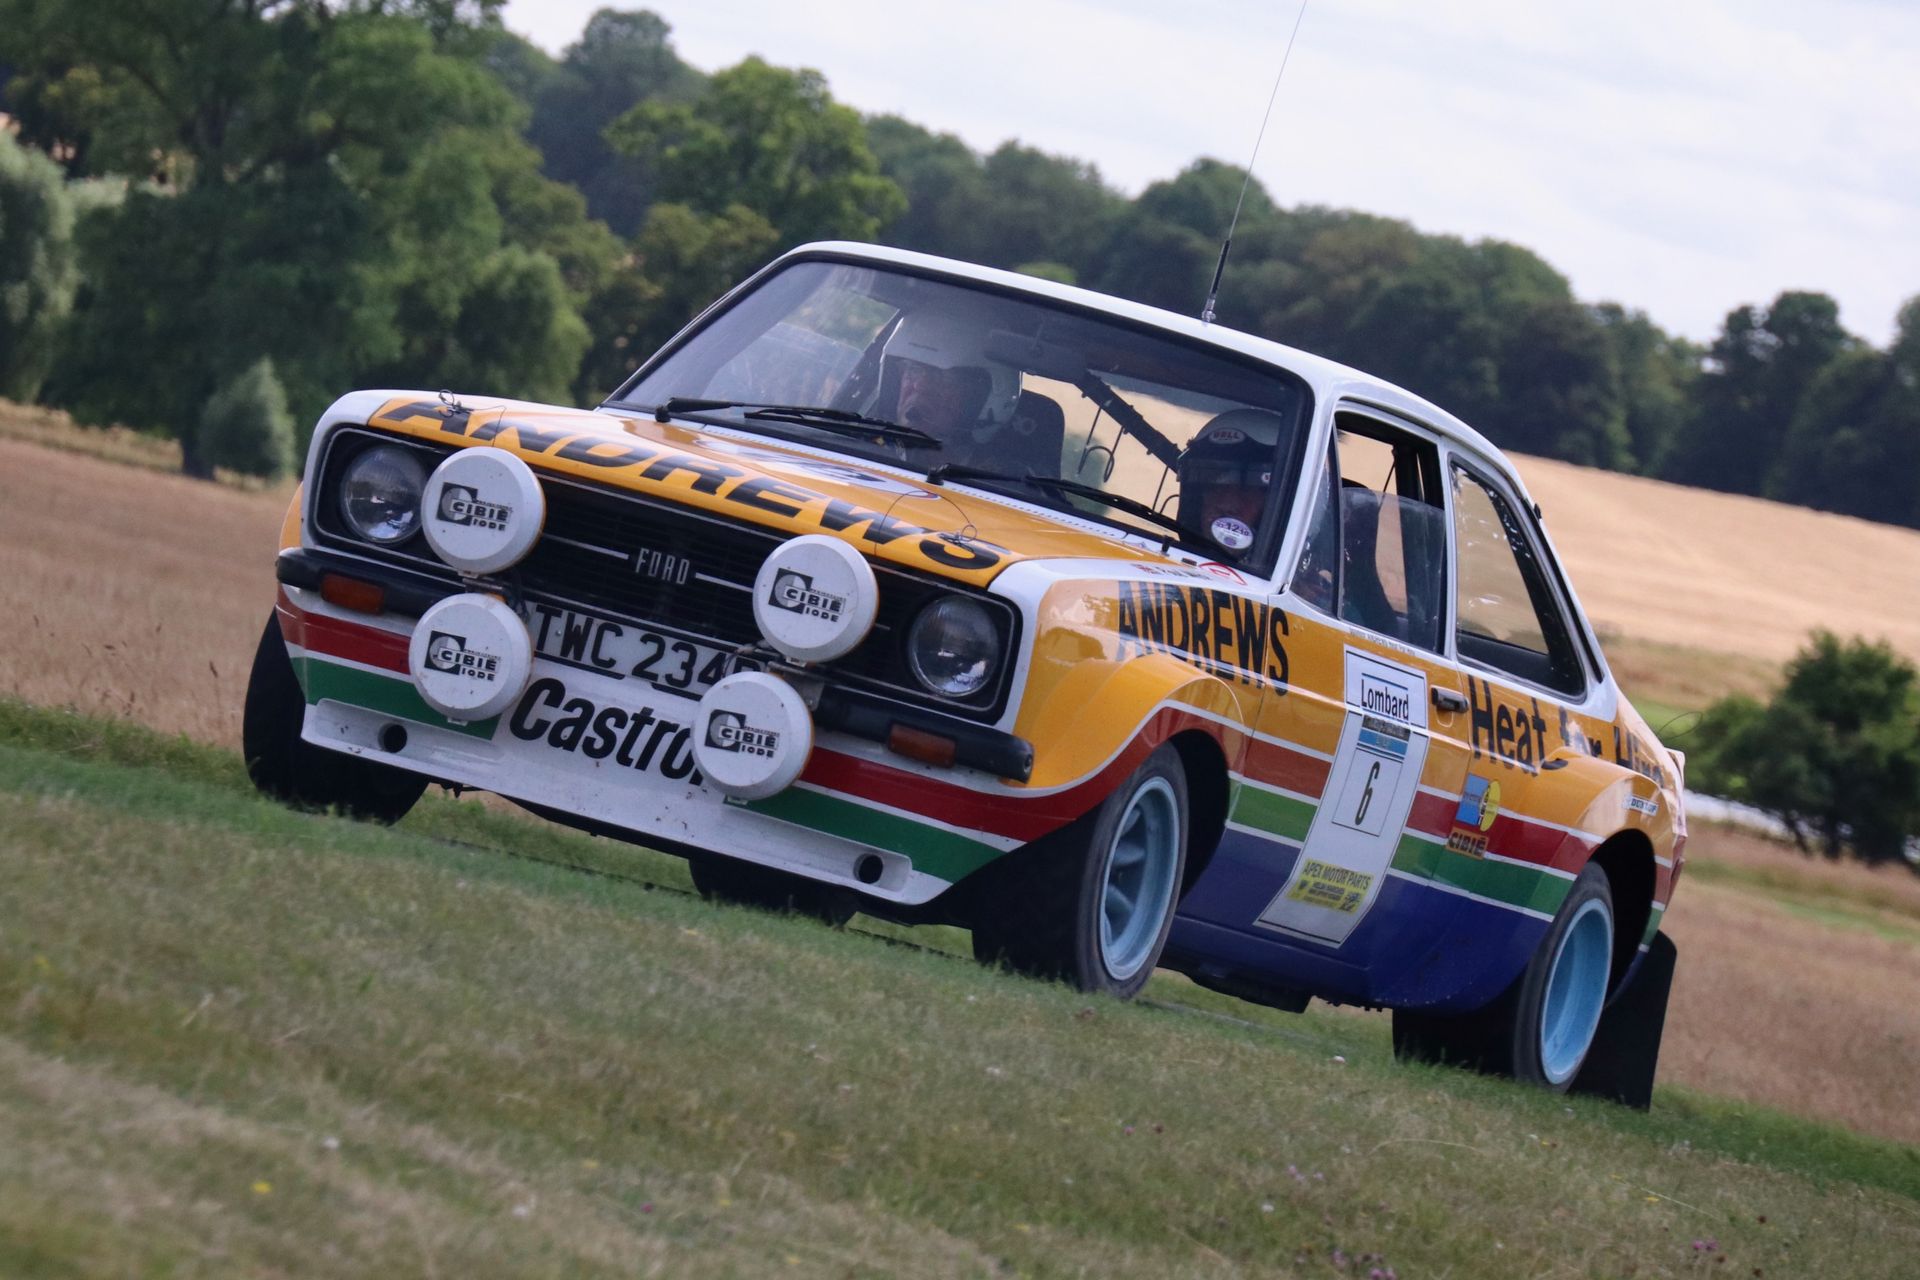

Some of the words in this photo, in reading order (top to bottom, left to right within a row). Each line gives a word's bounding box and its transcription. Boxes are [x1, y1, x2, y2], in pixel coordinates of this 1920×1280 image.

[379, 401, 1012, 569] ANDREWS
[635, 548, 691, 586] FORD
[535, 604, 624, 670] TWC
[805, 607, 839, 622] IODE
[1116, 580, 1289, 697] ANDREWS
[462, 667, 495, 681] IODE
[1361, 679, 1409, 721] Lombard
[509, 677, 704, 786] Castro
[742, 744, 775, 758] IODE
[1468, 674, 1568, 777] Heat
[1355, 761, 1380, 825] 6
